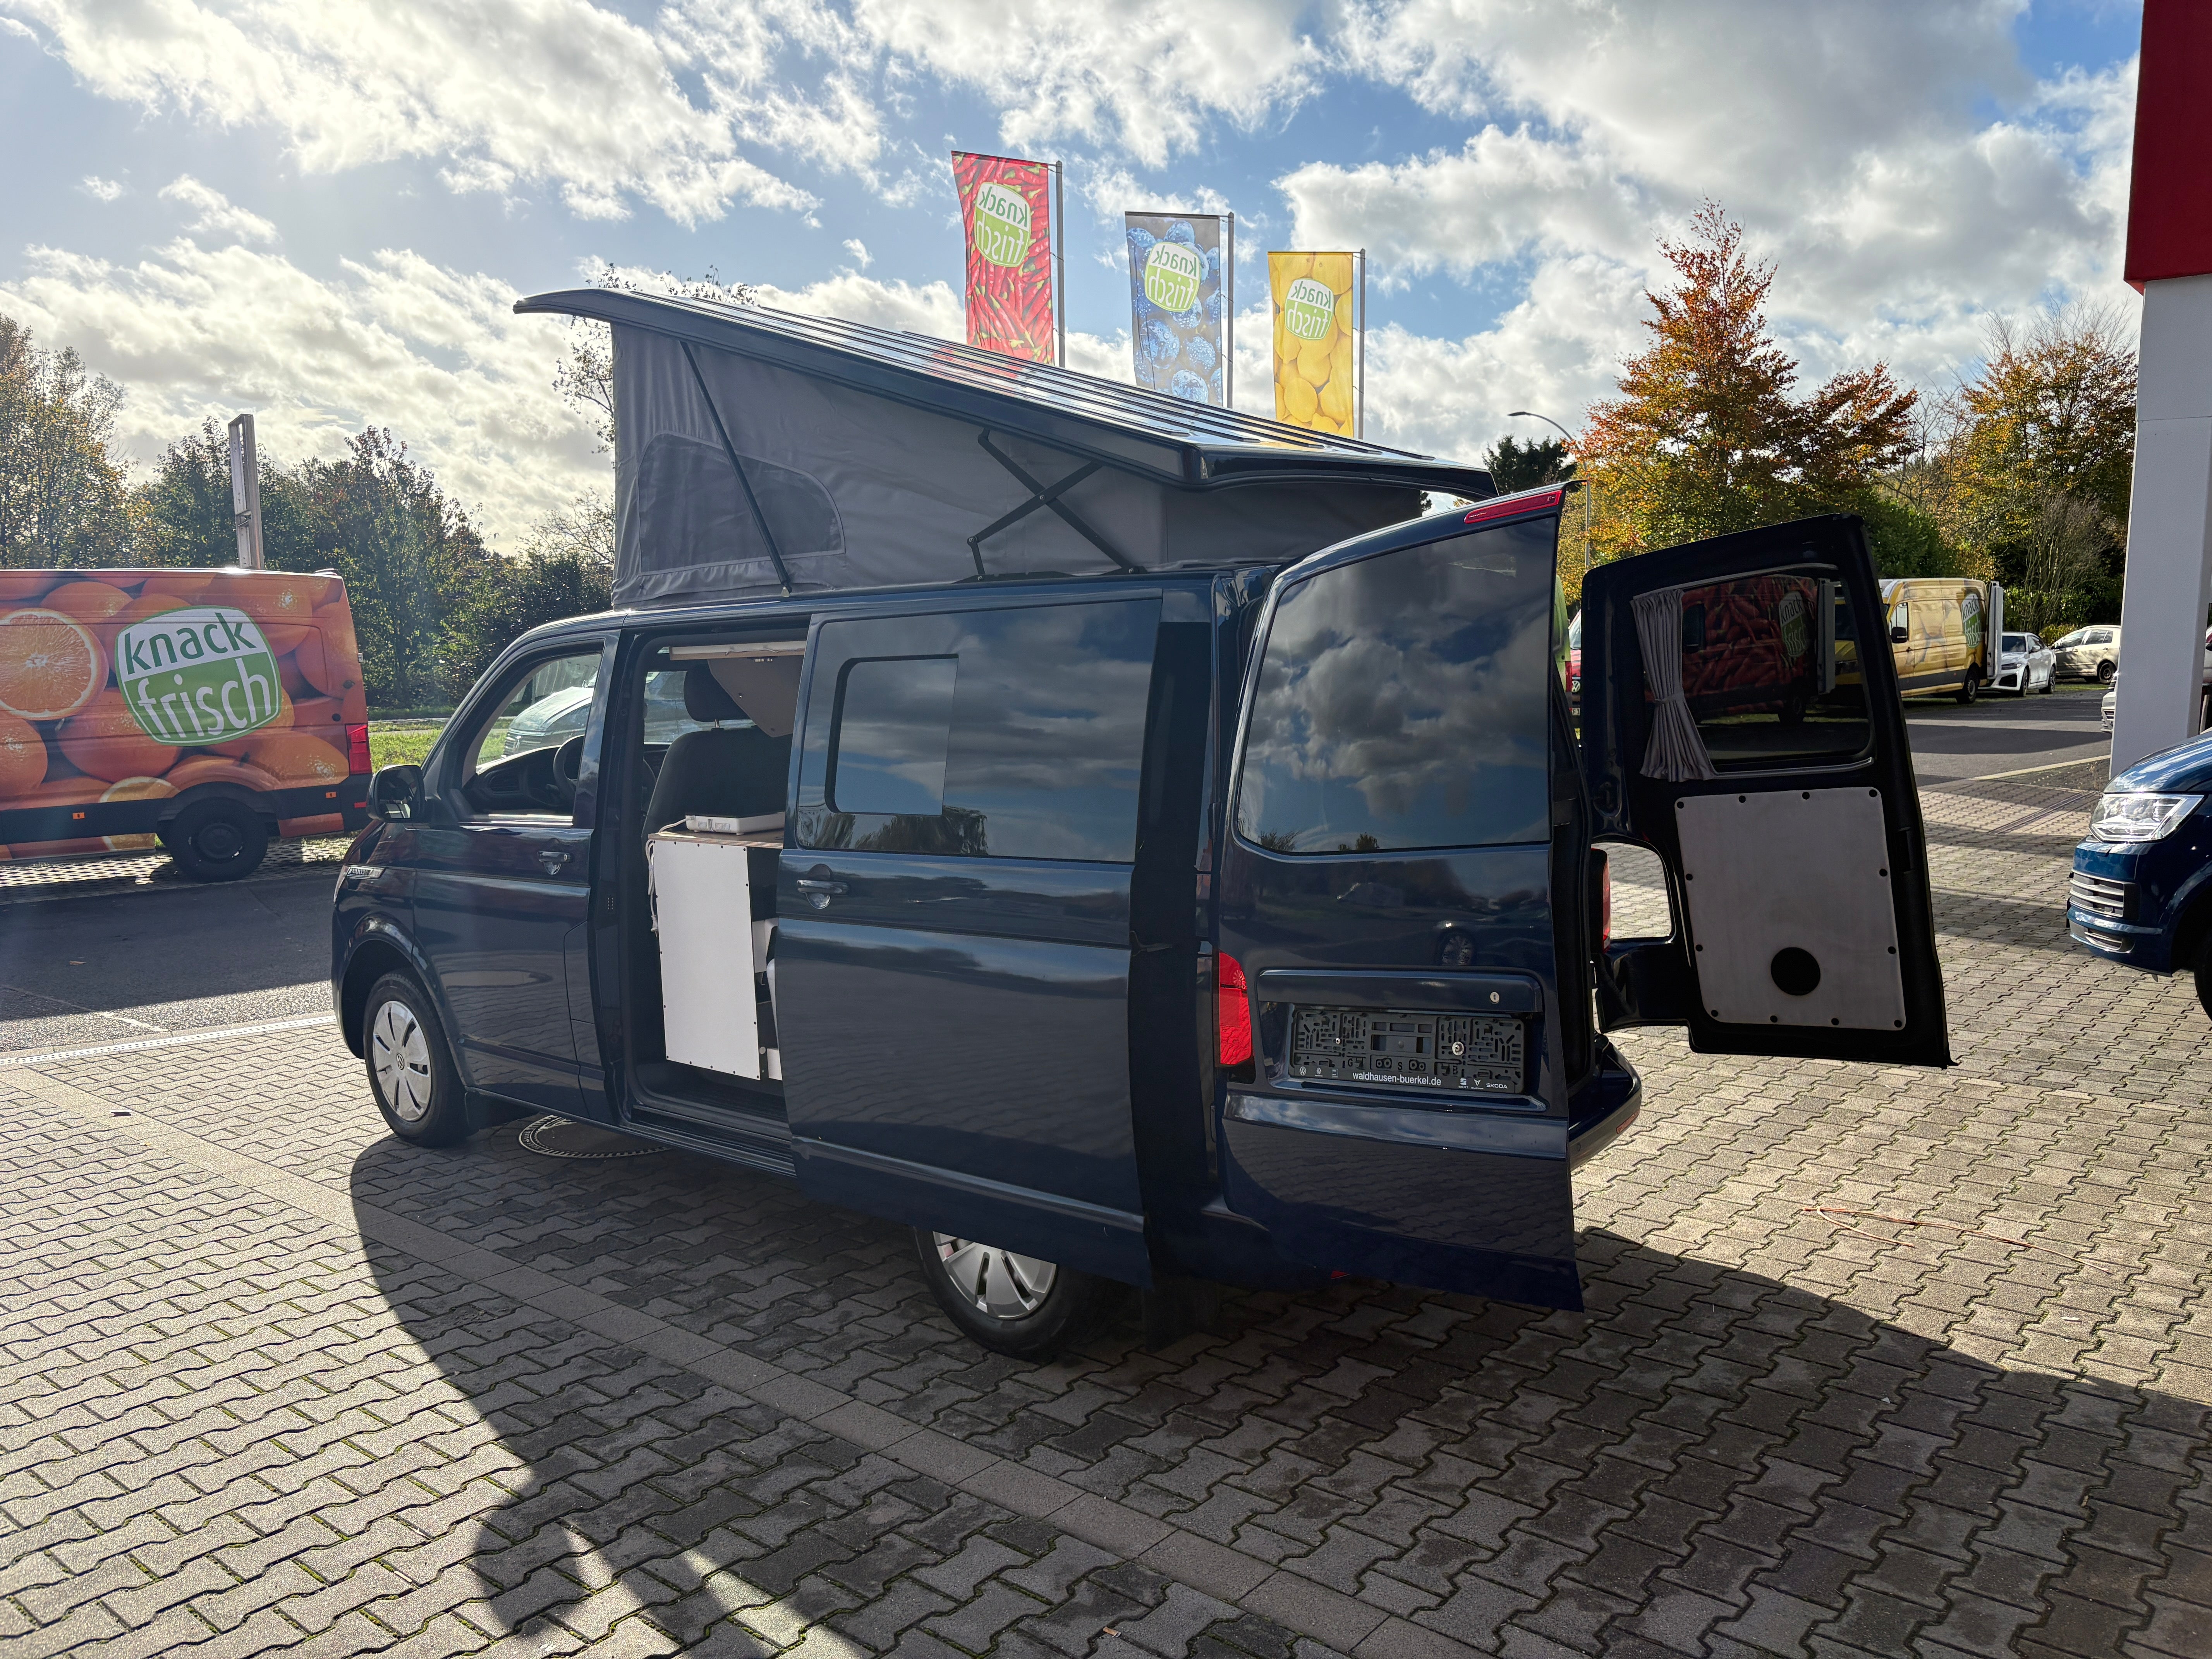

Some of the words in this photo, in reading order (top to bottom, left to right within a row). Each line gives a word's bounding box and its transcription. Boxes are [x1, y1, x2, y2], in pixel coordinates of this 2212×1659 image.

[1780, 595, 1803, 624] knack
[1962, 595, 1979, 620] knack
[124, 612, 257, 675] knack
[1965, 613, 1981, 646] frisch
[137, 658, 271, 738] frisch
[1352, 1071, 1442, 1086] waldhausen-buerkel.de
